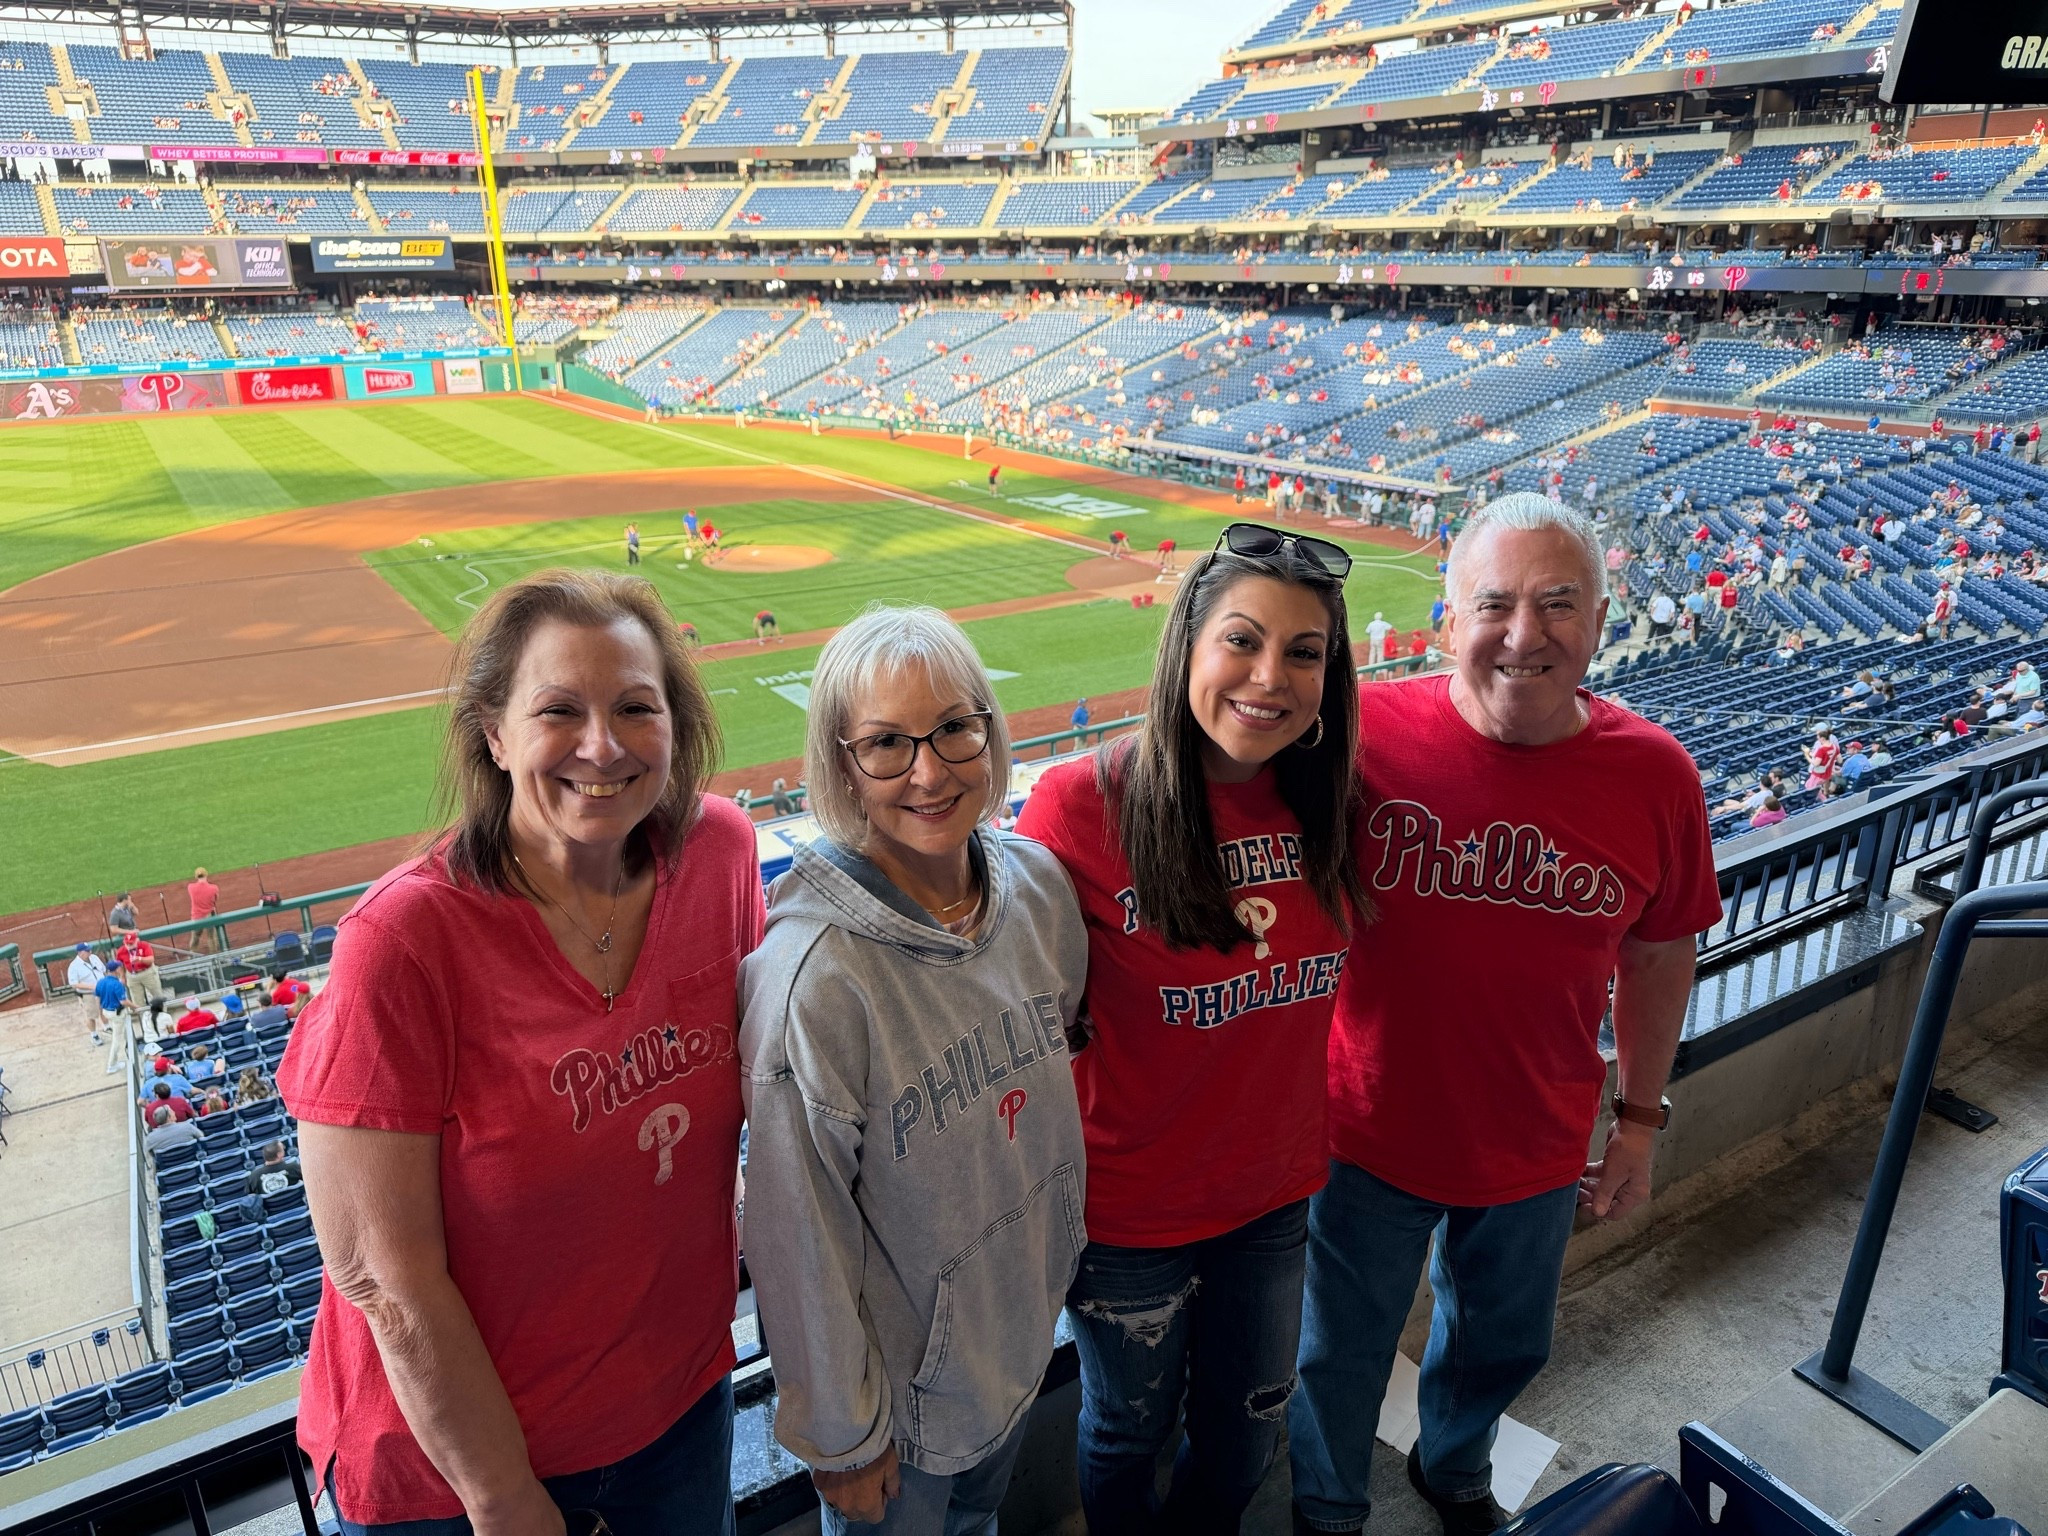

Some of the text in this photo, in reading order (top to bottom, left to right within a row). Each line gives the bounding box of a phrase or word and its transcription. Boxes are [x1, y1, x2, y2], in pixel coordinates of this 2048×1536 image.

[1, 145, 105, 157] SCIO'S BAKERY
[157, 148, 189, 158] WHEY
[193, 149, 231, 159] BETTER
[234, 150, 278, 160] PROTEIN
[0, 248, 58, 268] OTA
[244, 246, 283, 263] KDI
[318, 240, 401, 256] theScore
[1647, 266, 1674, 290] A's
[16, 382, 74, 420] A's
[138, 372, 184, 412] P
[251, 373, 323, 401] Chick-fil-A
[1369, 800, 1625, 917] Phillies
[1234, 896, 1277, 960] P
[1159, 947, 1349, 1029] PHILLIES
[890, 988, 1069, 1160] PHILLIE
[998, 1087, 1027, 1147] P
[637, 1103, 691, 1187] P
